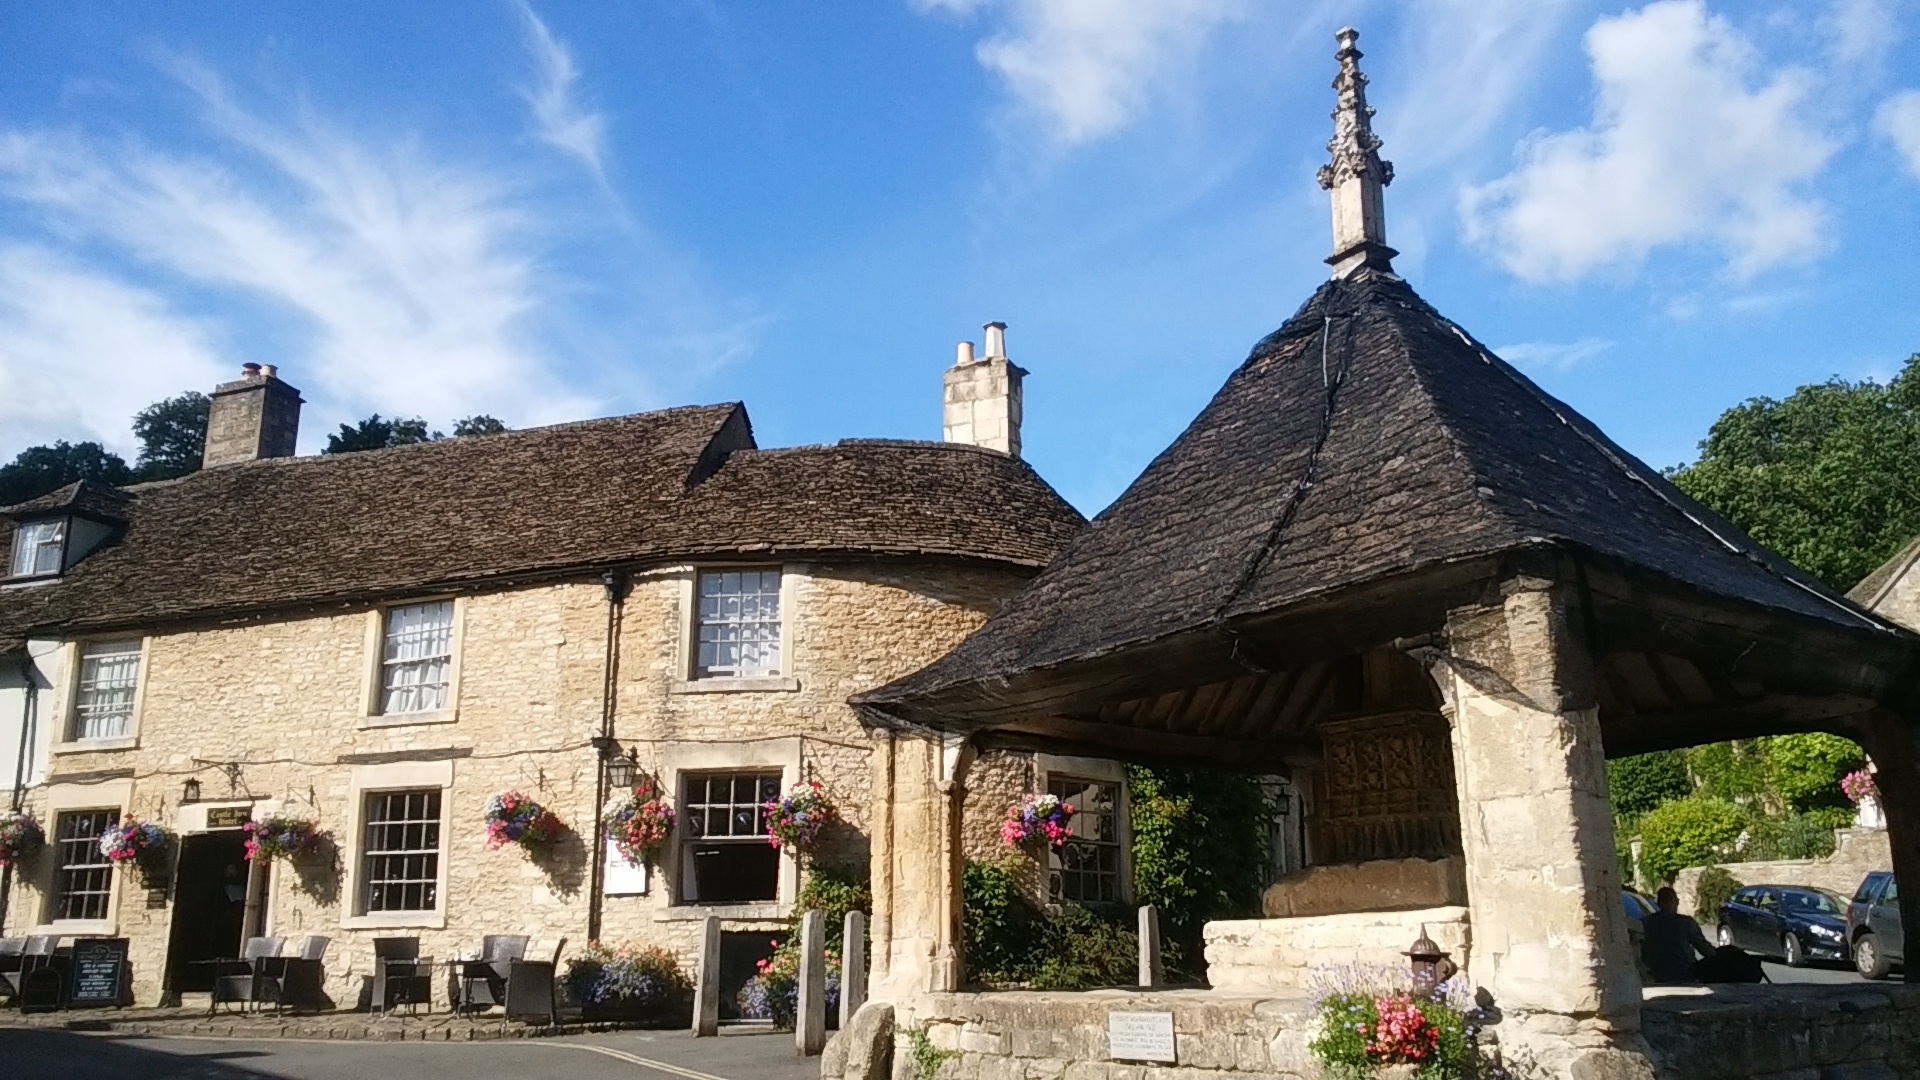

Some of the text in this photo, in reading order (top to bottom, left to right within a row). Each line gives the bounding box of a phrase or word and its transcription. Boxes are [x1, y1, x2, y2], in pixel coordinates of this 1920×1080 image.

[210, 809, 248, 819] Castle Inn
[218, 817, 237, 825] Hotel
